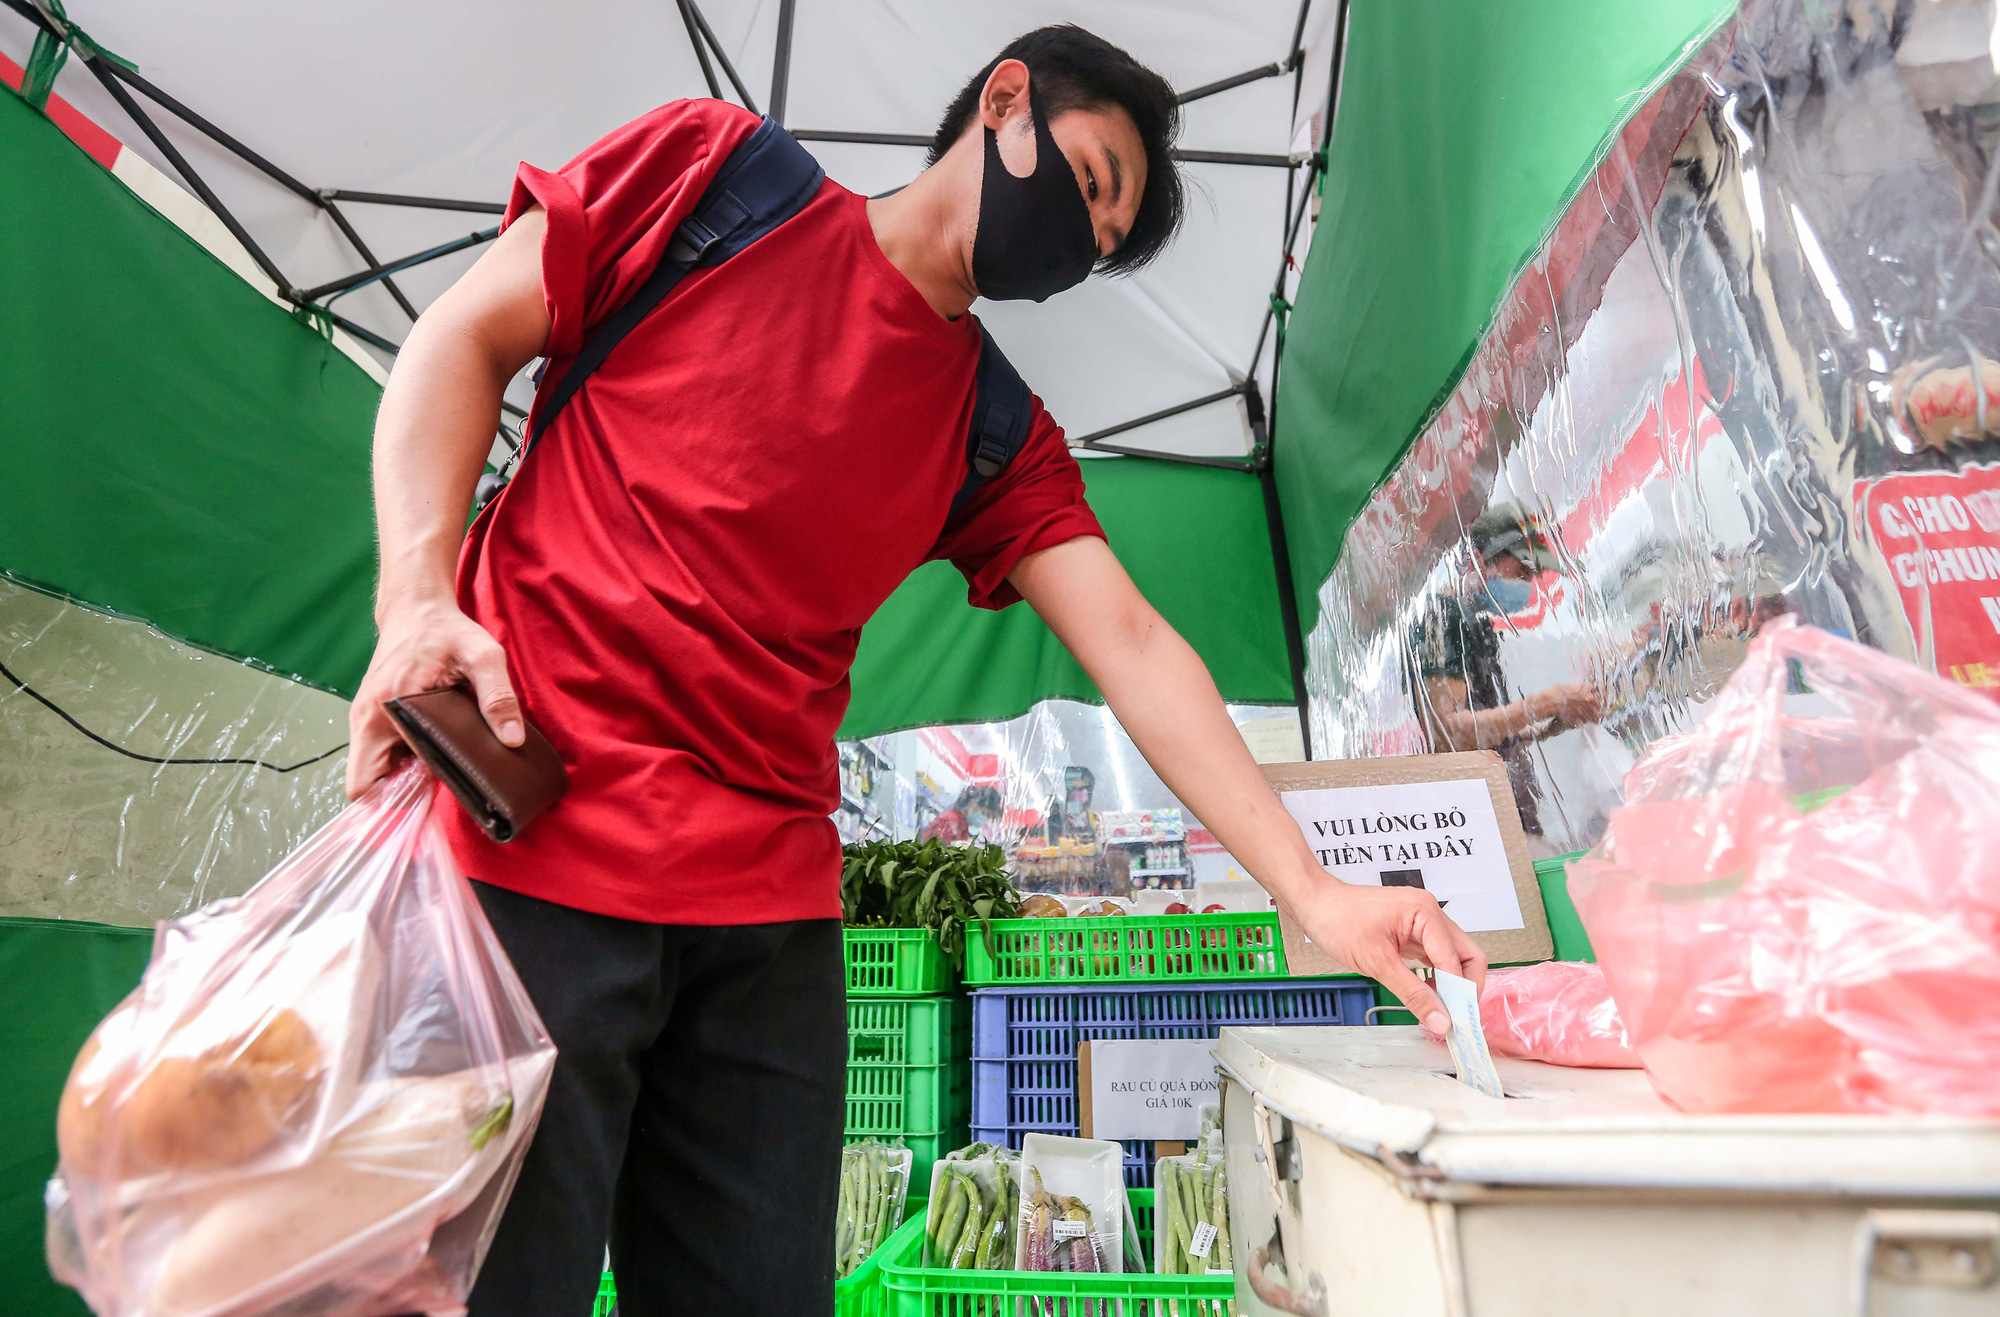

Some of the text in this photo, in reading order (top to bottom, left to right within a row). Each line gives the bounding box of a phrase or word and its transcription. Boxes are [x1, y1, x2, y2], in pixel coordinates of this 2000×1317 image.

[1312, 806, 1467, 838] VUI LÒNG BỎ
[1316, 835, 1475, 867] TIỀN TẠI ĐÂY
[1111, 1081, 1137, 1092] RAU
[1139, 1078, 1157, 1092] CỦ
[1160, 1078, 1187, 1093] QUẢ
[1145, 1095, 1193, 1109] GIÁ 10K
